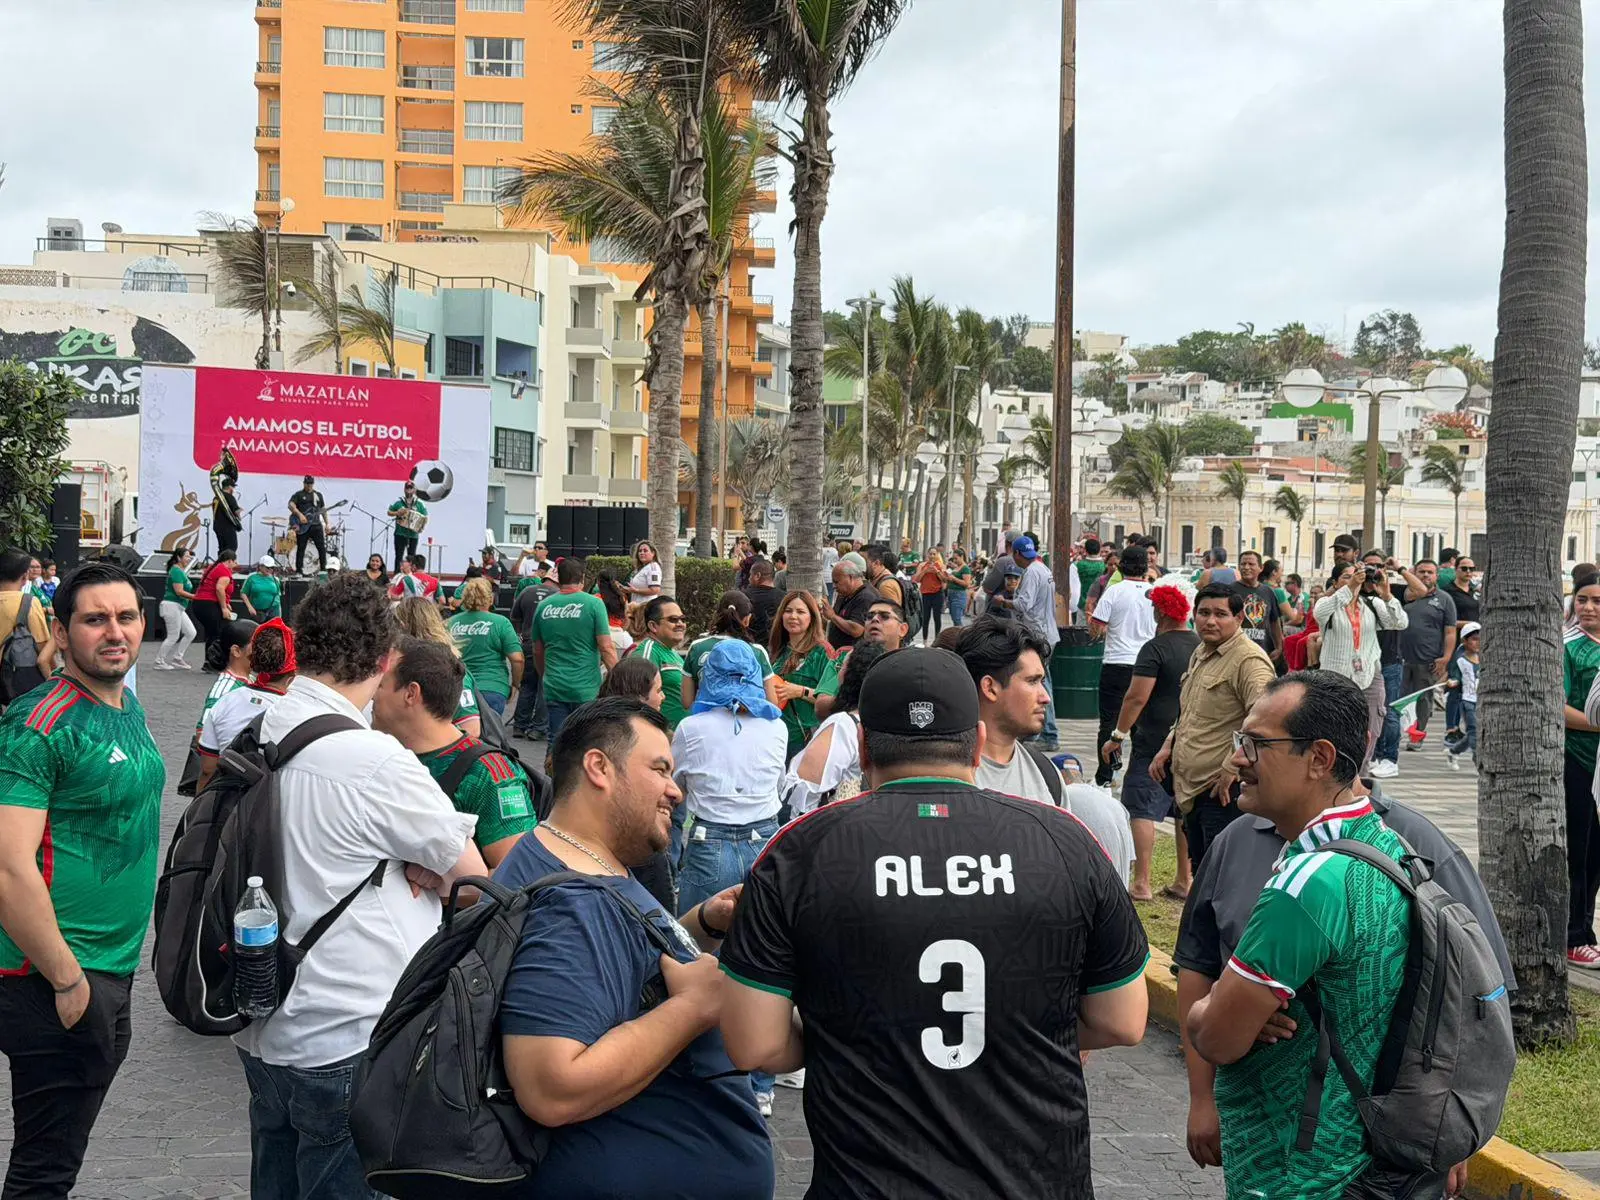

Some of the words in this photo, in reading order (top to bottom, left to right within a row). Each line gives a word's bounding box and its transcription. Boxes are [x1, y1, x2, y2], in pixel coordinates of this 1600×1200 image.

[280, 383, 370, 402] MAZATLÁN
[223, 415, 314, 435] AMAMOS
[317, 420, 338, 437] EL
[342, 419, 412, 441] FÚTBOL
[314, 442, 413, 461] MAZATLÁN!
[908, 701, 934, 712] LMB
[875, 853, 1016, 897] ALEX
[919, 939, 985, 1070] 3
